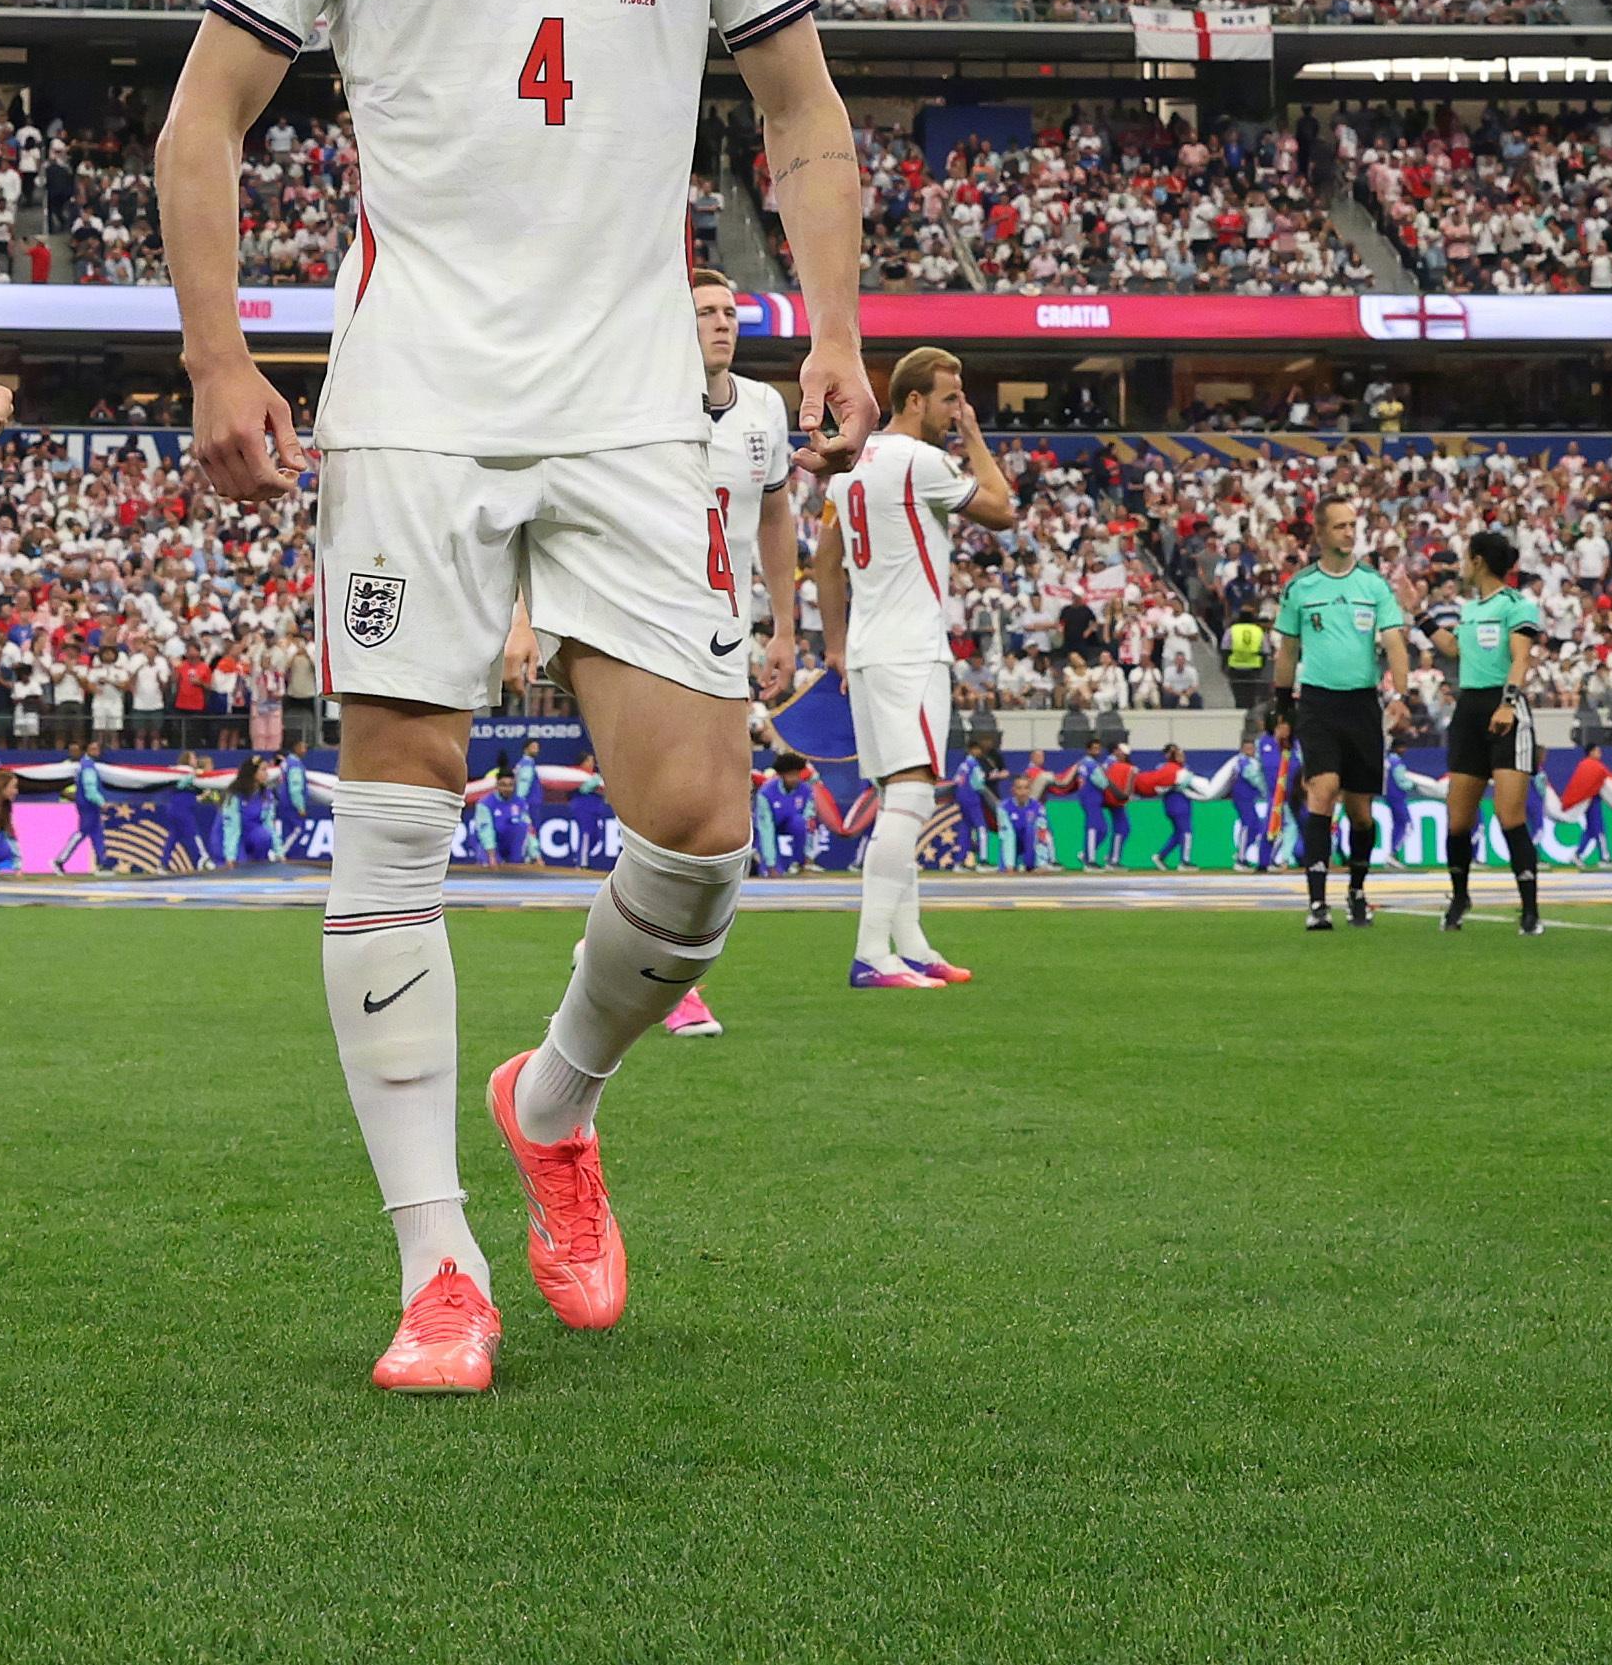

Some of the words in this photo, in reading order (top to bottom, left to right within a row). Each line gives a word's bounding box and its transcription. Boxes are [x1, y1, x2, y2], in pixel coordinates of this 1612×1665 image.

[517, 17, 573, 126] 4
[1036, 304, 1111, 328] CROATIA
[706, 507, 740, 618] 4
[848, 480, 871, 569] 9
